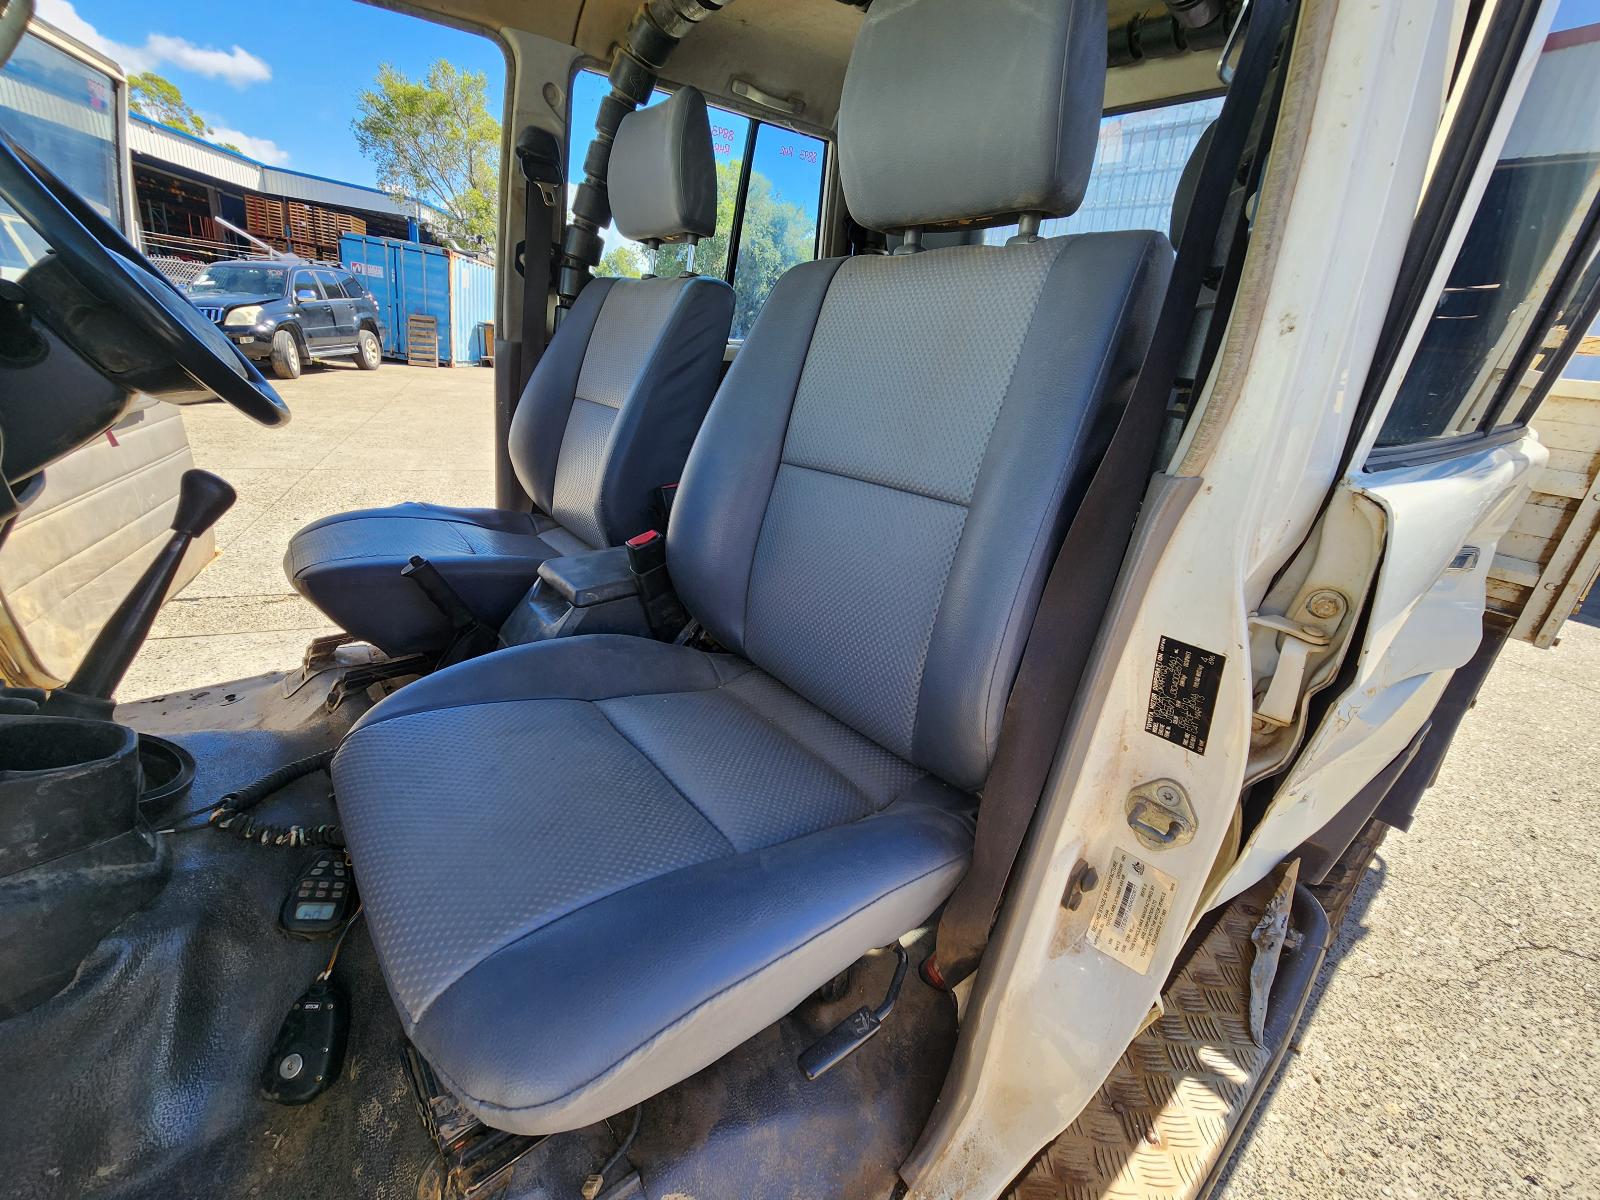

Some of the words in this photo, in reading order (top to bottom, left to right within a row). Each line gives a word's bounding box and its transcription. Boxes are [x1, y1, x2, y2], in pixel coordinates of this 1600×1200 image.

[1146, 711, 1154, 731] TOYOTA
[1154, 653, 1164, 691] CORPORATION
[1092, 912, 1102, 933] SECOND
[1098, 897, 1107, 913] STAGE
[1105, 861, 1119, 892] MANUFACTURE
